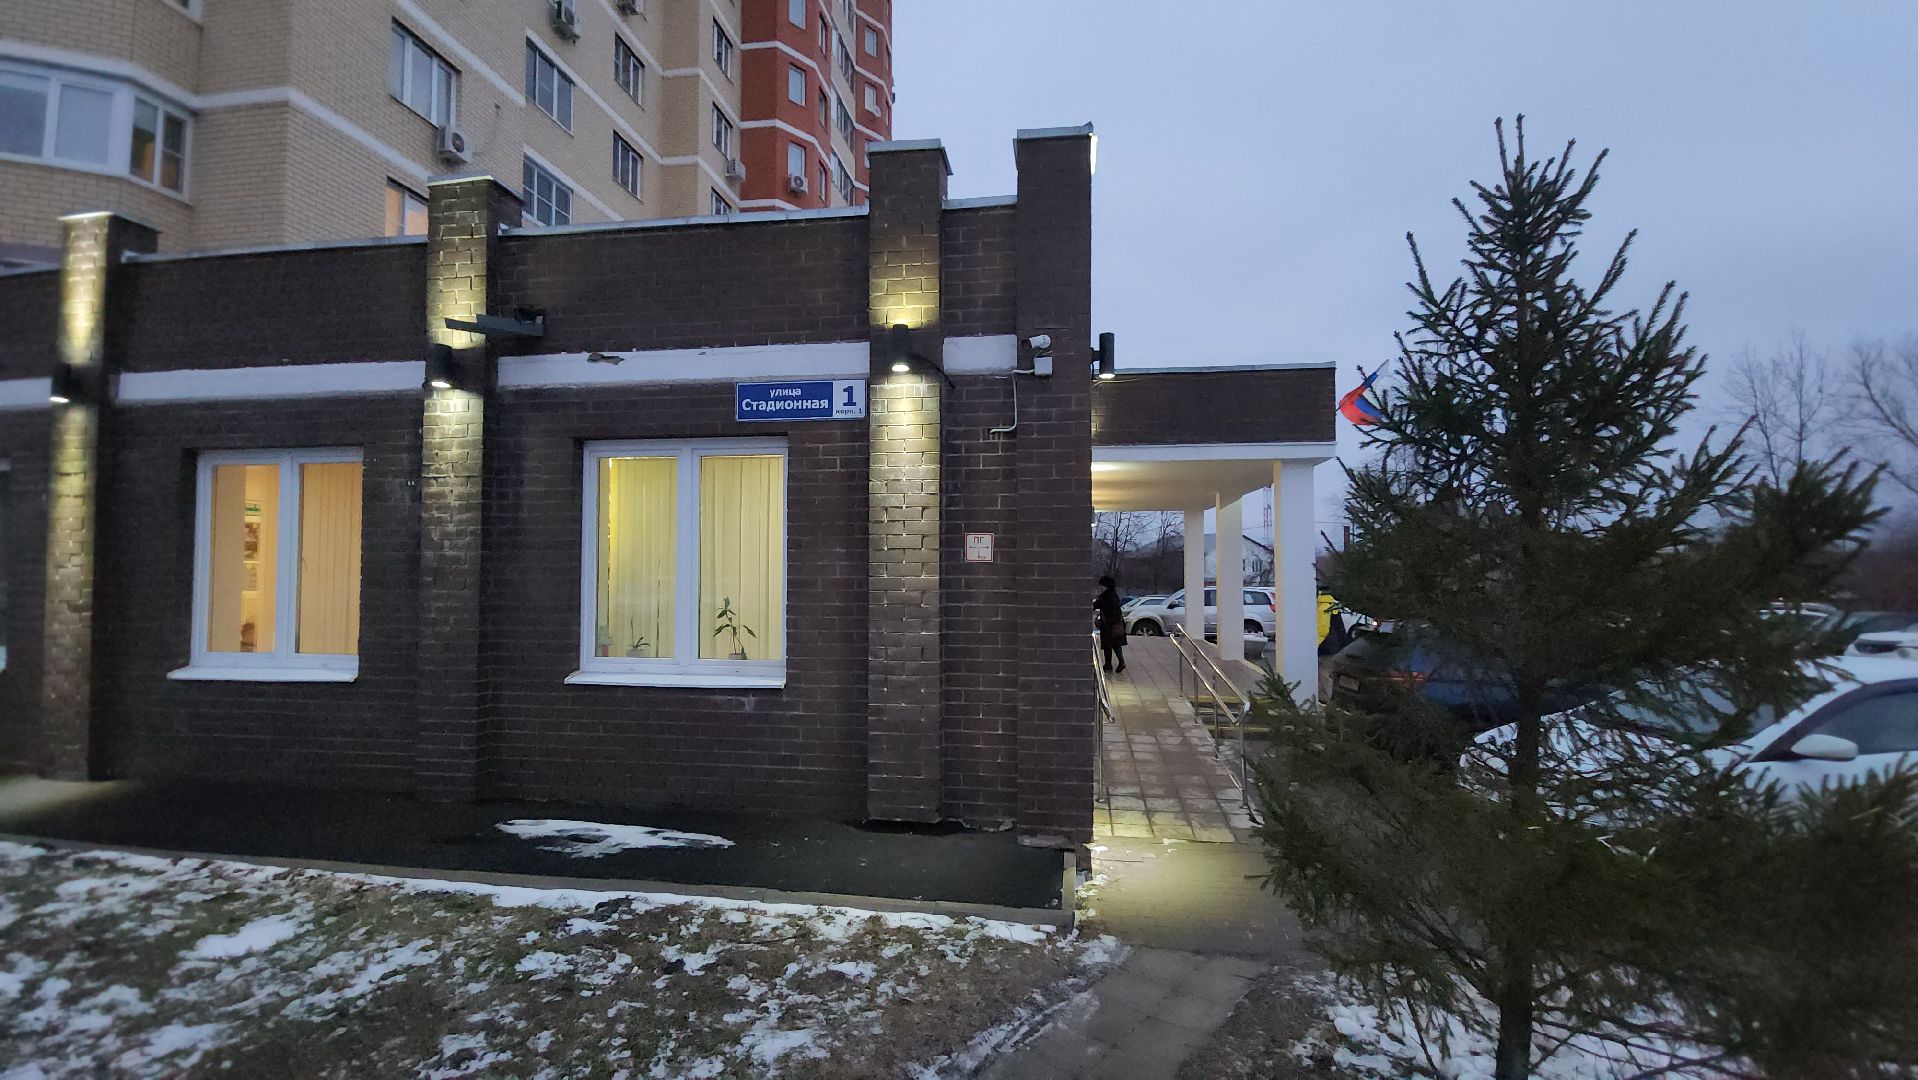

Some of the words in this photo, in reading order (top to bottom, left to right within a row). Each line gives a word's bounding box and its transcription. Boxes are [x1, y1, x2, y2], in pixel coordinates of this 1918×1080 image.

[769, 388, 802, 398] улица
[842, 385, 857, 407] 1
[742, 398, 829, 412] Стадионная
[973, 536, 985, 544] ПГ
